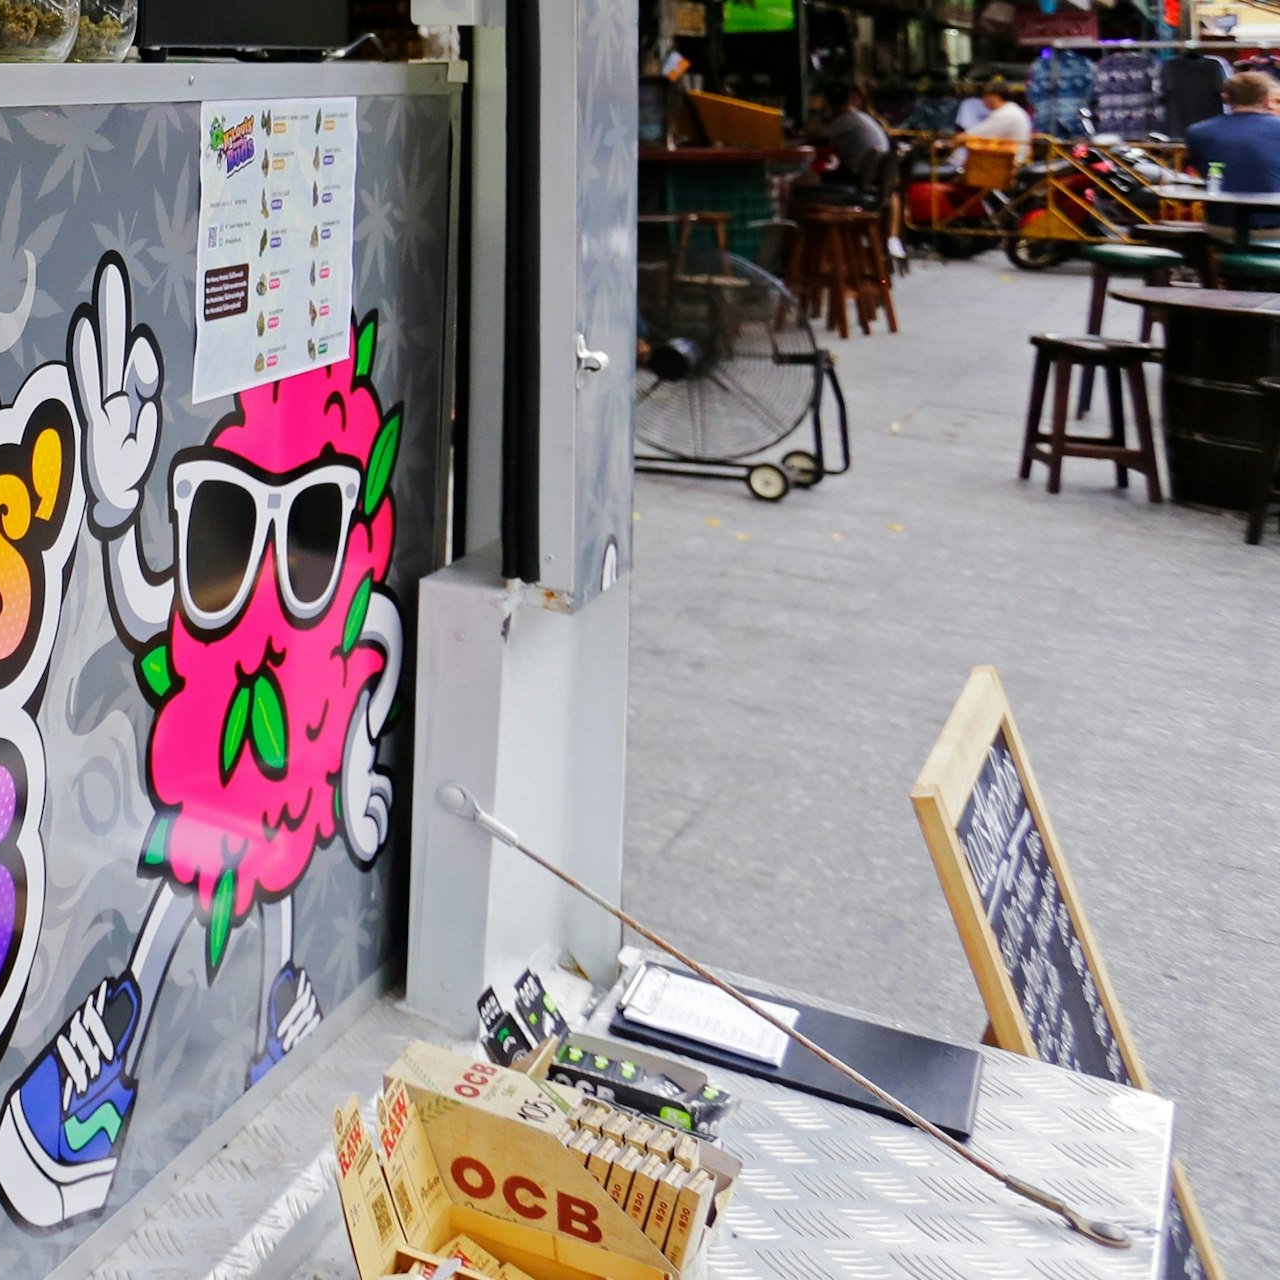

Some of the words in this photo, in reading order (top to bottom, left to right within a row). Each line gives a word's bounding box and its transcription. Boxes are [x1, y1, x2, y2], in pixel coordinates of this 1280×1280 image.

[454, 1063, 497, 1098] OCB
[338, 1119, 364, 1180] RAW
[381, 1090, 409, 1162] RAW
[450, 1156, 603, 1244] OCB
